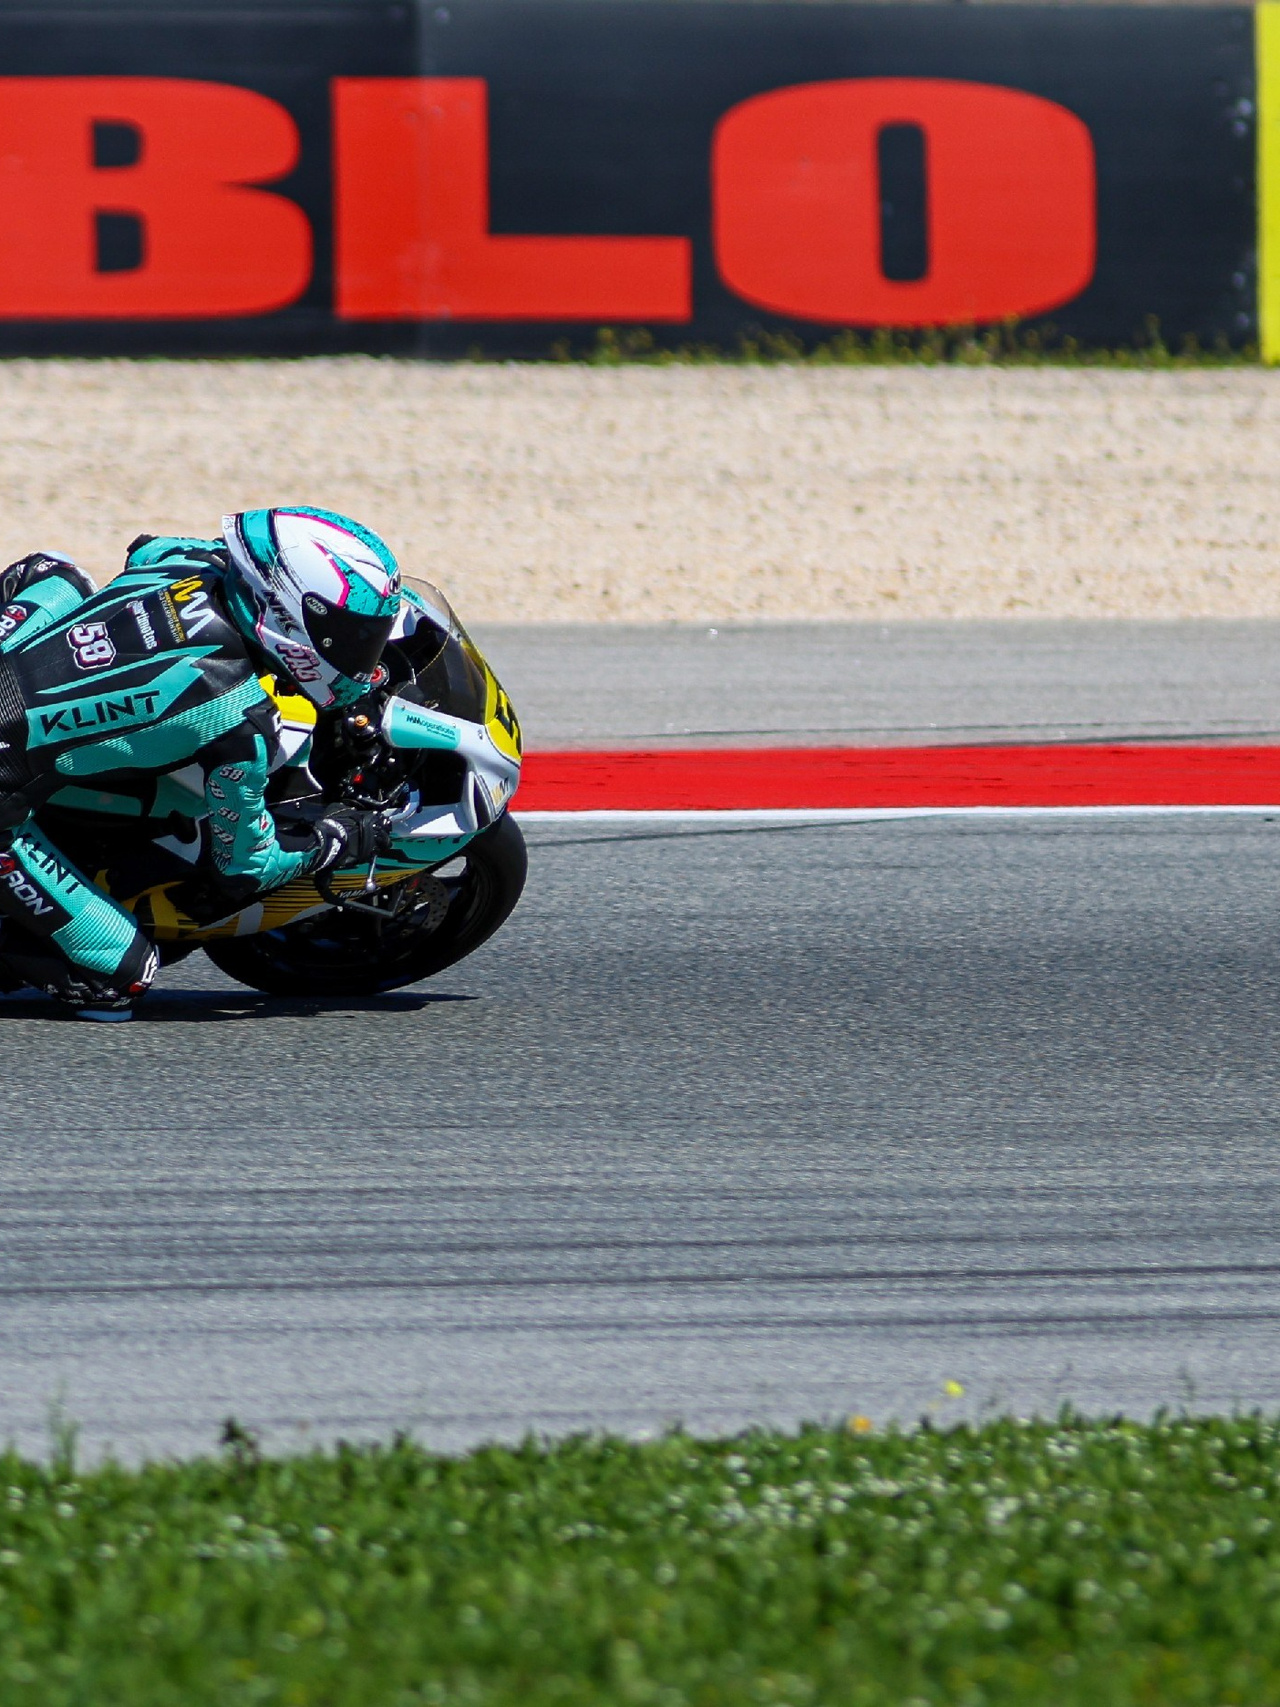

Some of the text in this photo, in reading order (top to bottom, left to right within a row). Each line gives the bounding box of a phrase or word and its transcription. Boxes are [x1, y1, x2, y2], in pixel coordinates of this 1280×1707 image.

[66, 622, 116, 670] 58
[40, 690, 160, 737] KLINT
[219, 765, 246, 783] 58
[218, 806, 241, 822] 58
[20, 832, 88, 895] KLINT
